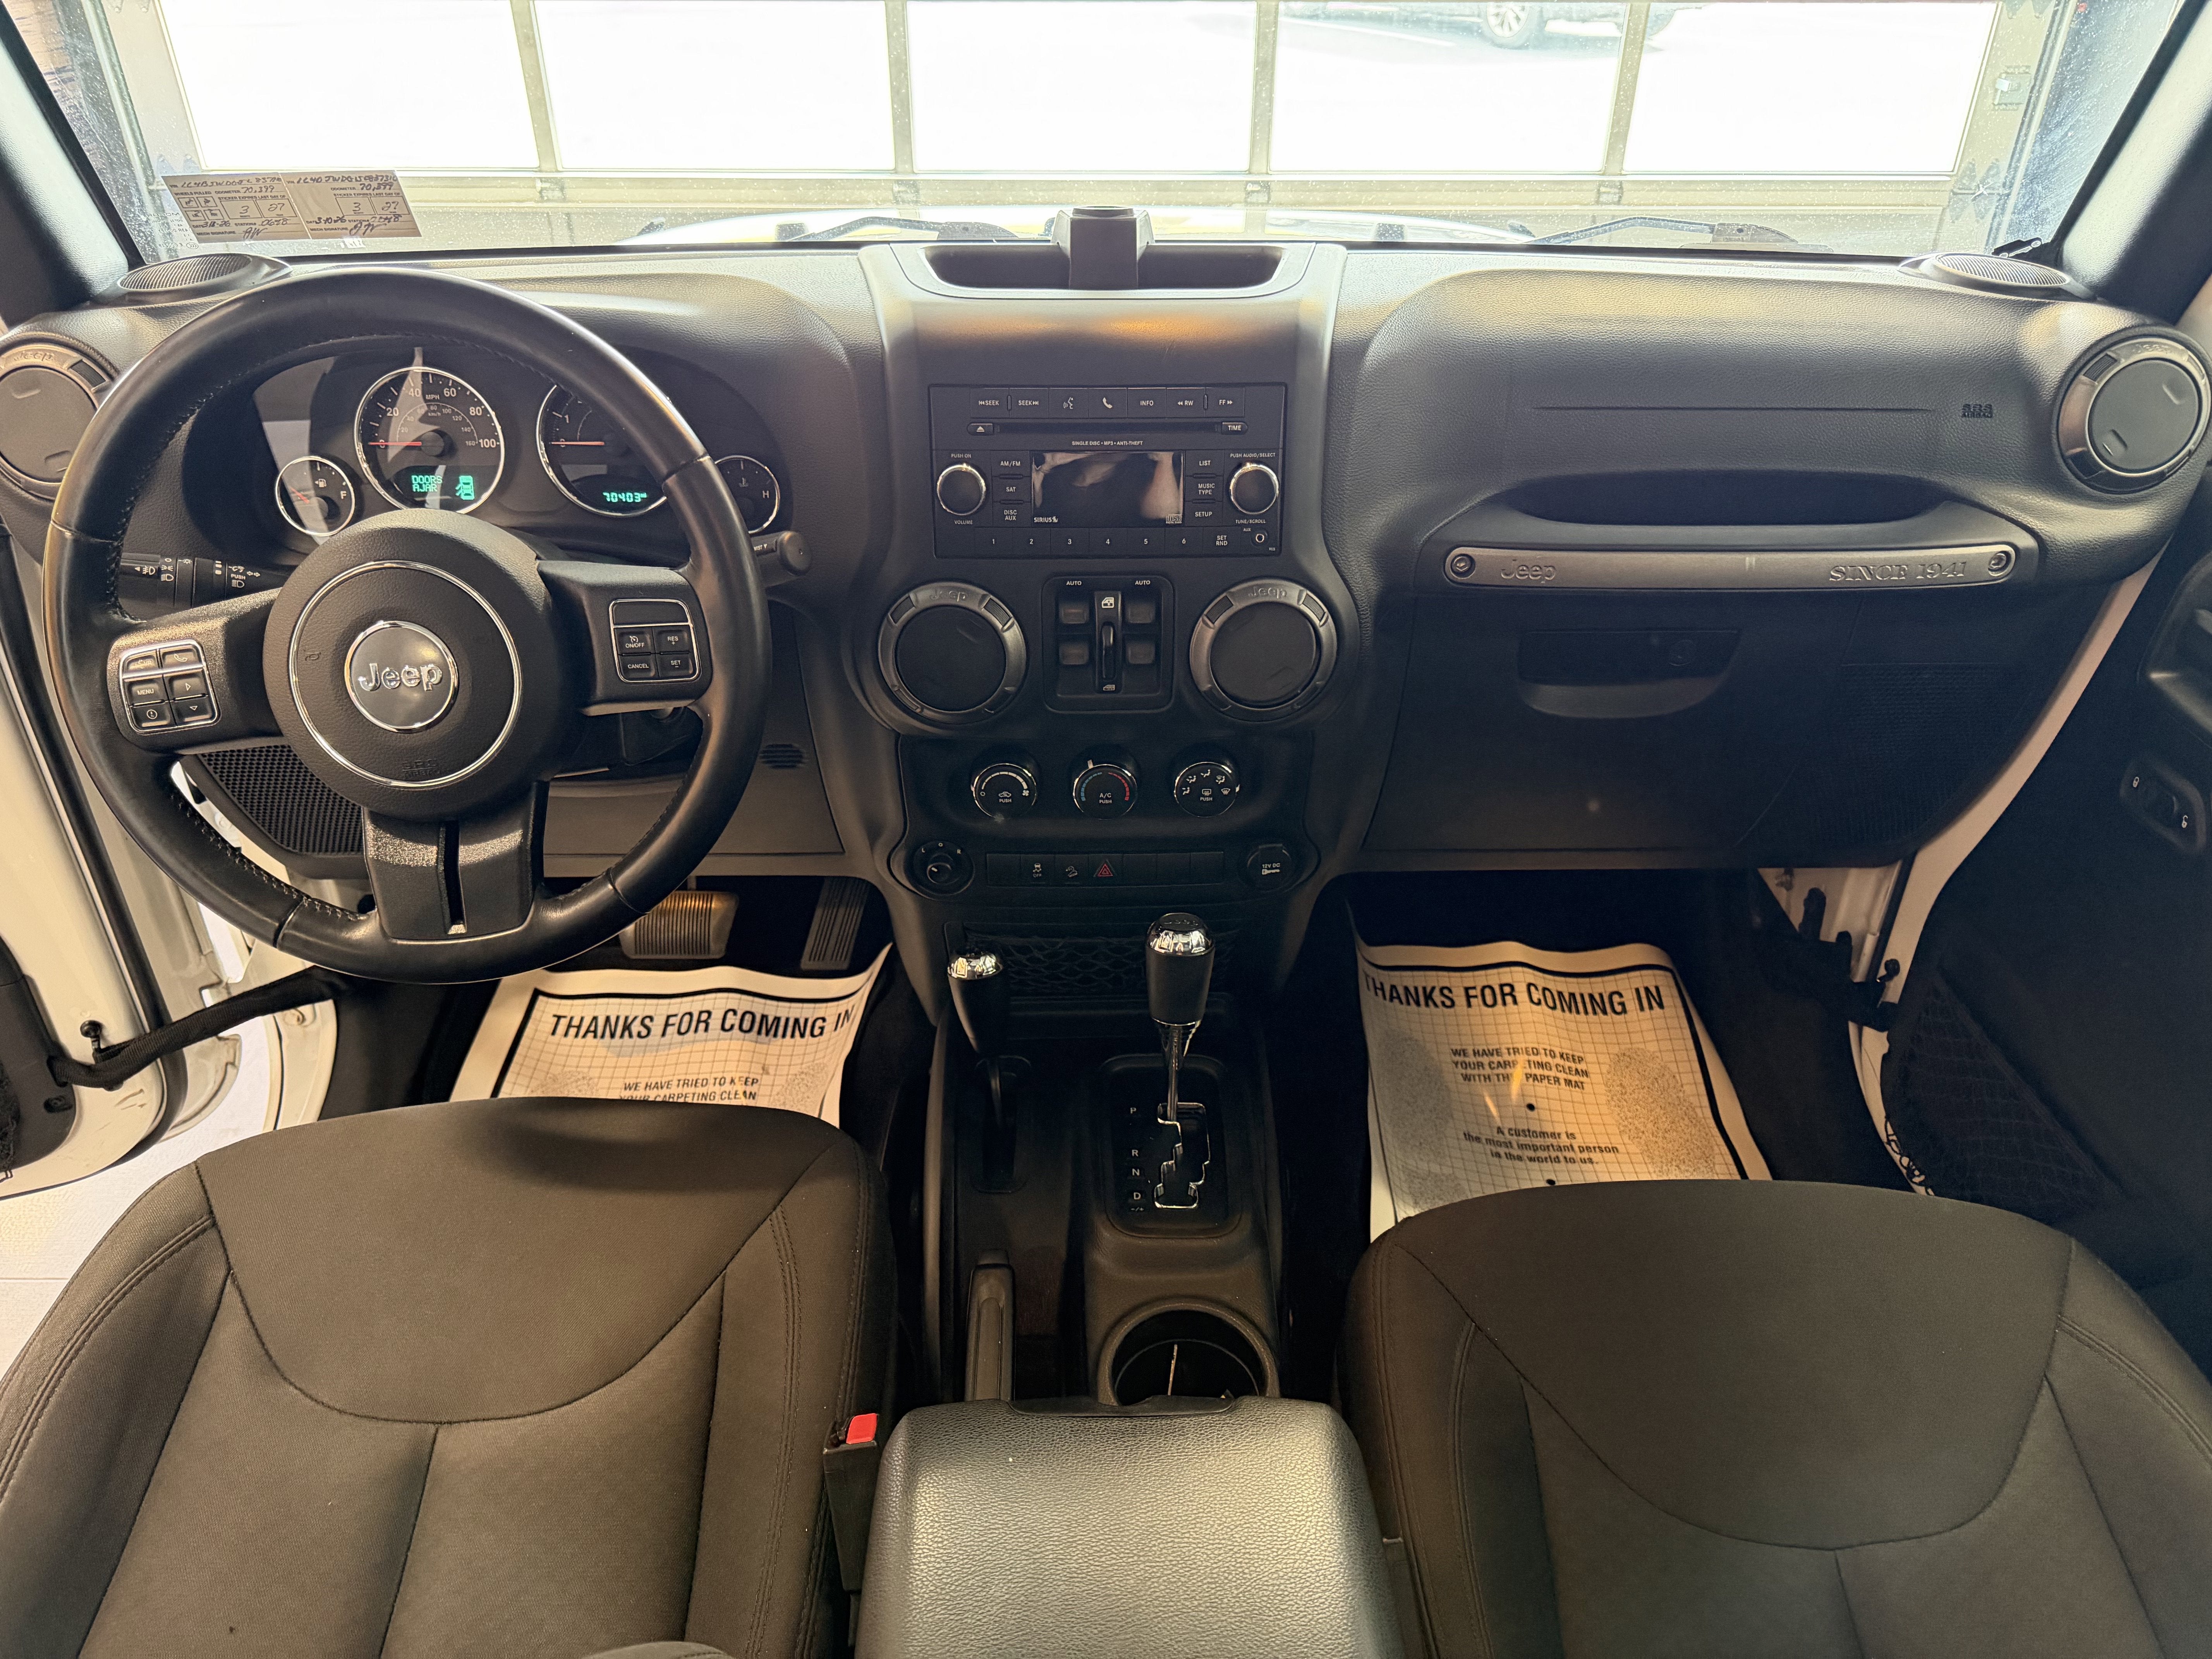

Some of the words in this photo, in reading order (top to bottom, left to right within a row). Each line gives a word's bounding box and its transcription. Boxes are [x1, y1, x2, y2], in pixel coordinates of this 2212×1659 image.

[239, 206, 249, 214] 3
[268, 203, 285, 211] 27
[352, 202, 361, 211] 3
[382, 201, 399, 211] 27
[409, 388, 421, 397] 40
[444, 388, 456, 397] 60
[386, 407, 399, 416] 20
[469, 407, 482, 416] 80
[564, 414, 569, 423] 1
[478, 438, 496, 448] 100
[411, 475, 443, 484] DOORS
[340, 491, 347, 499] F
[603, 492, 641, 502] 70403
[762, 491, 769, 499] H
[1501, 559, 1556, 584] Jeep
[1829, 565, 1908, 581] SINCE
[1916, 562, 1966, 579] 1941
[1248, 587, 1287, 599] Jeep
[358, 663, 443, 692] Jeep
[1364, 974, 1455, 1008] THANKS
[1463, 982, 1518, 1008] FOR
[1527, 982, 1626, 1016] COMING
[1636, 986, 1664, 1012] IN
[550, 1015, 655, 1039] THANKS
[661, 1010, 713, 1037] FOR
[720, 1008, 827, 1039] COMING
[833, 1007, 854, 1032] IN
[1451, 1048, 1468, 1058] WE
[1472, 1048, 1502, 1057] HAVE
[1506, 1047, 1539, 1056] TRIED
[1542, 1048, 1556, 1059] TO
[1559, 1051, 1584, 1064] KEEP
[1452, 1061, 1484, 1070] YOUR
[1555, 1063, 1589, 1079] CLEAN
[624, 1082, 642, 1092] WE
[644, 1080, 673, 1091] HAVE
[676, 1078, 709, 1089] TRIED
[713, 1077, 726, 1087] TO
[730, 1076, 758, 1087] KEEP
[1461, 1073, 1491, 1083] WITH
[1525, 1073, 1561, 1086] PAPER
[1564, 1079, 1585, 1091] MAT
[654, 1092, 716, 1103] CARPETING
[721, 1090, 756, 1101] CLEAN
[1497, 1127, 1504, 1136] A
[1508, 1127, 1561, 1140] customer
[1565, 1131, 1576, 1140] is
[1463, 1131, 1481, 1143] the
[1485, 1137, 1513, 1150] most
[1516, 1141, 1575, 1153] important
[1578, 1145, 1619, 1154] person
[1490, 1150, 1501, 1159] in
[1504, 1152, 1523, 1161] the
[1527, 1155, 1560, 1164] world
